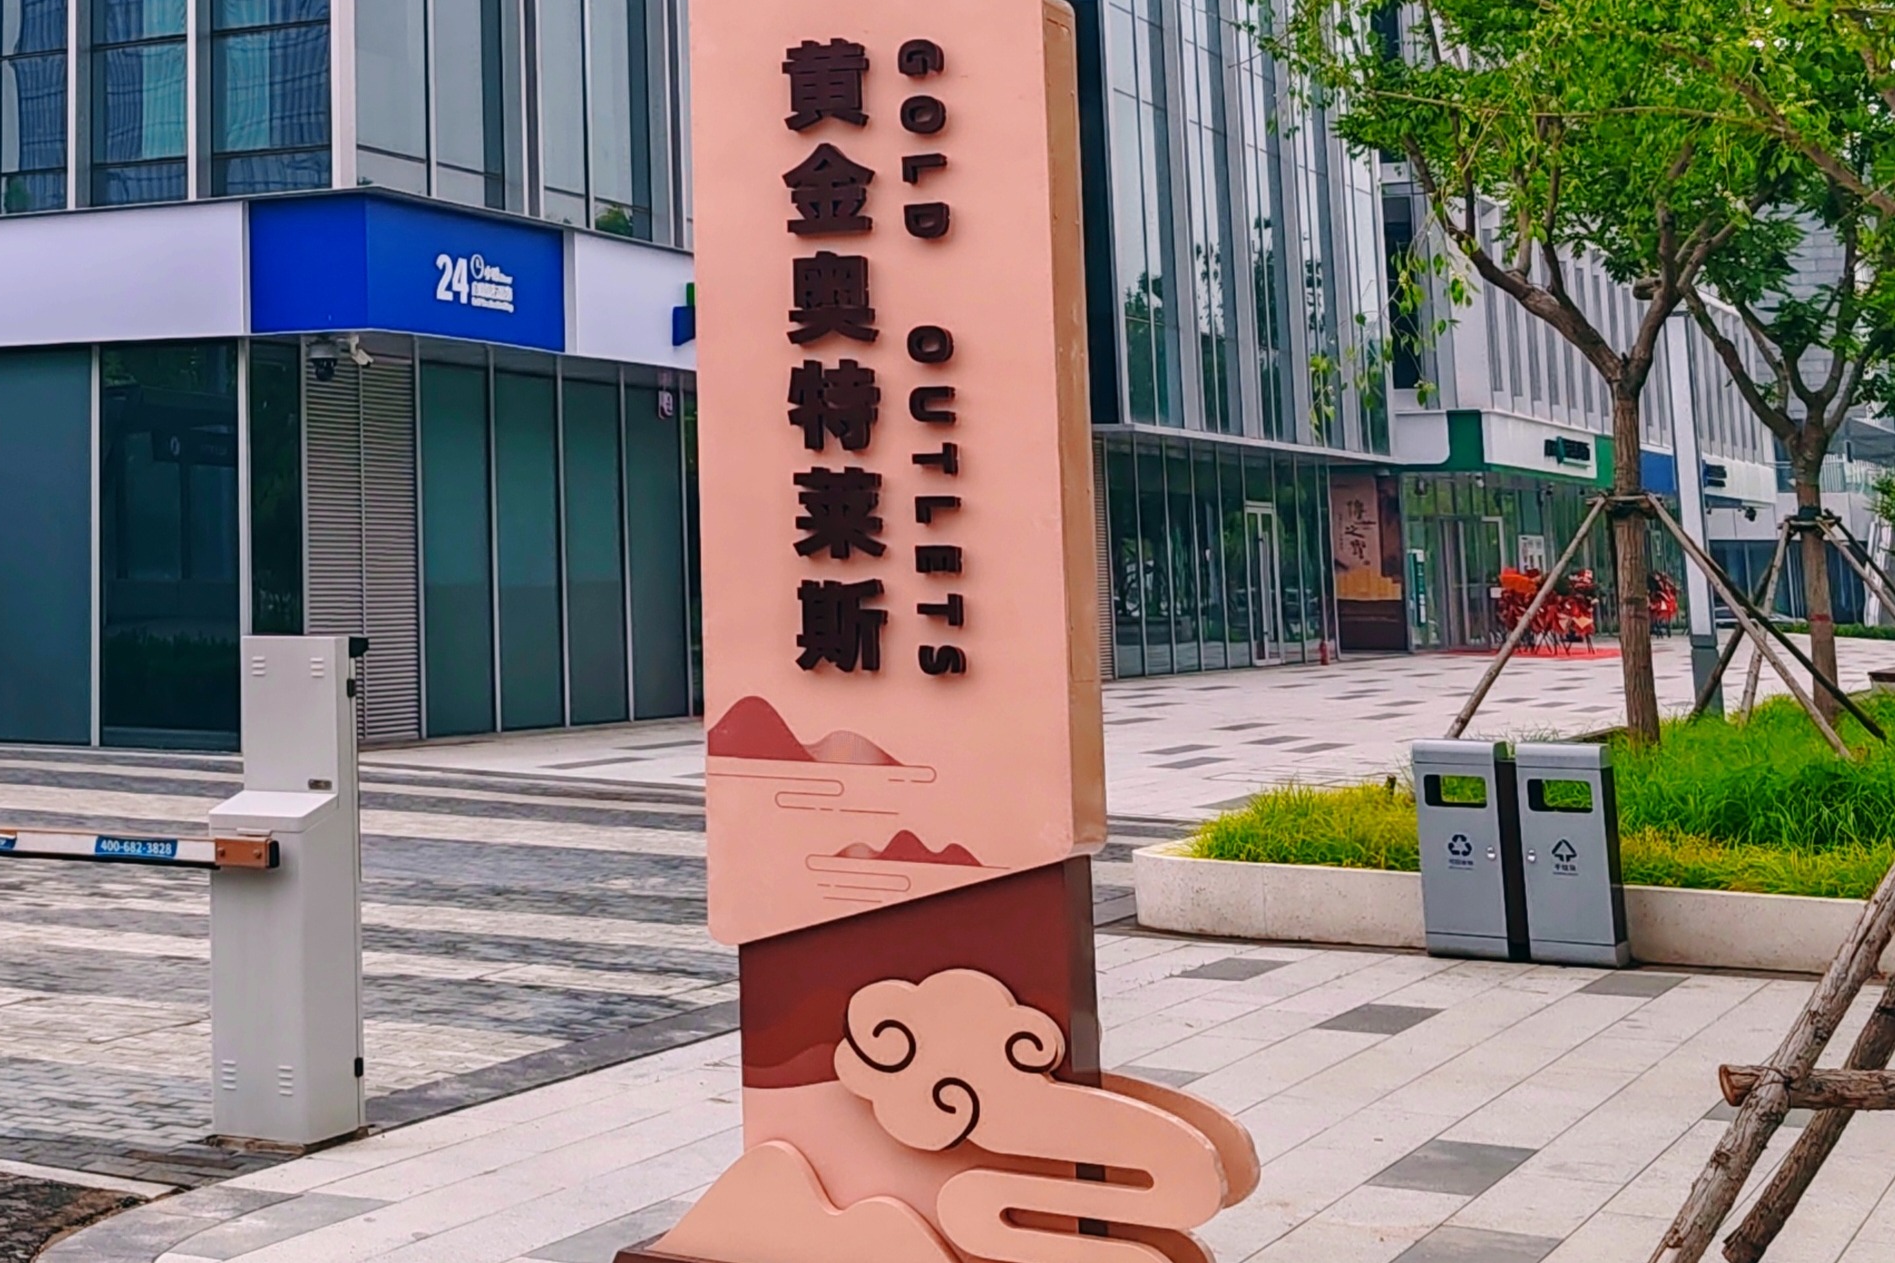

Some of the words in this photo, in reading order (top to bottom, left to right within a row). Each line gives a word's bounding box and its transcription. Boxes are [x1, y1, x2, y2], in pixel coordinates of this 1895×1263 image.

[897, 38, 951, 240] GOLD
[435, 253, 470, 305] 24
[782, 38, 888, 673] 黄金奥特莱斯
[906, 324, 967, 676] OUTLETS
[100, 839, 173, 856] 400-682-3828
